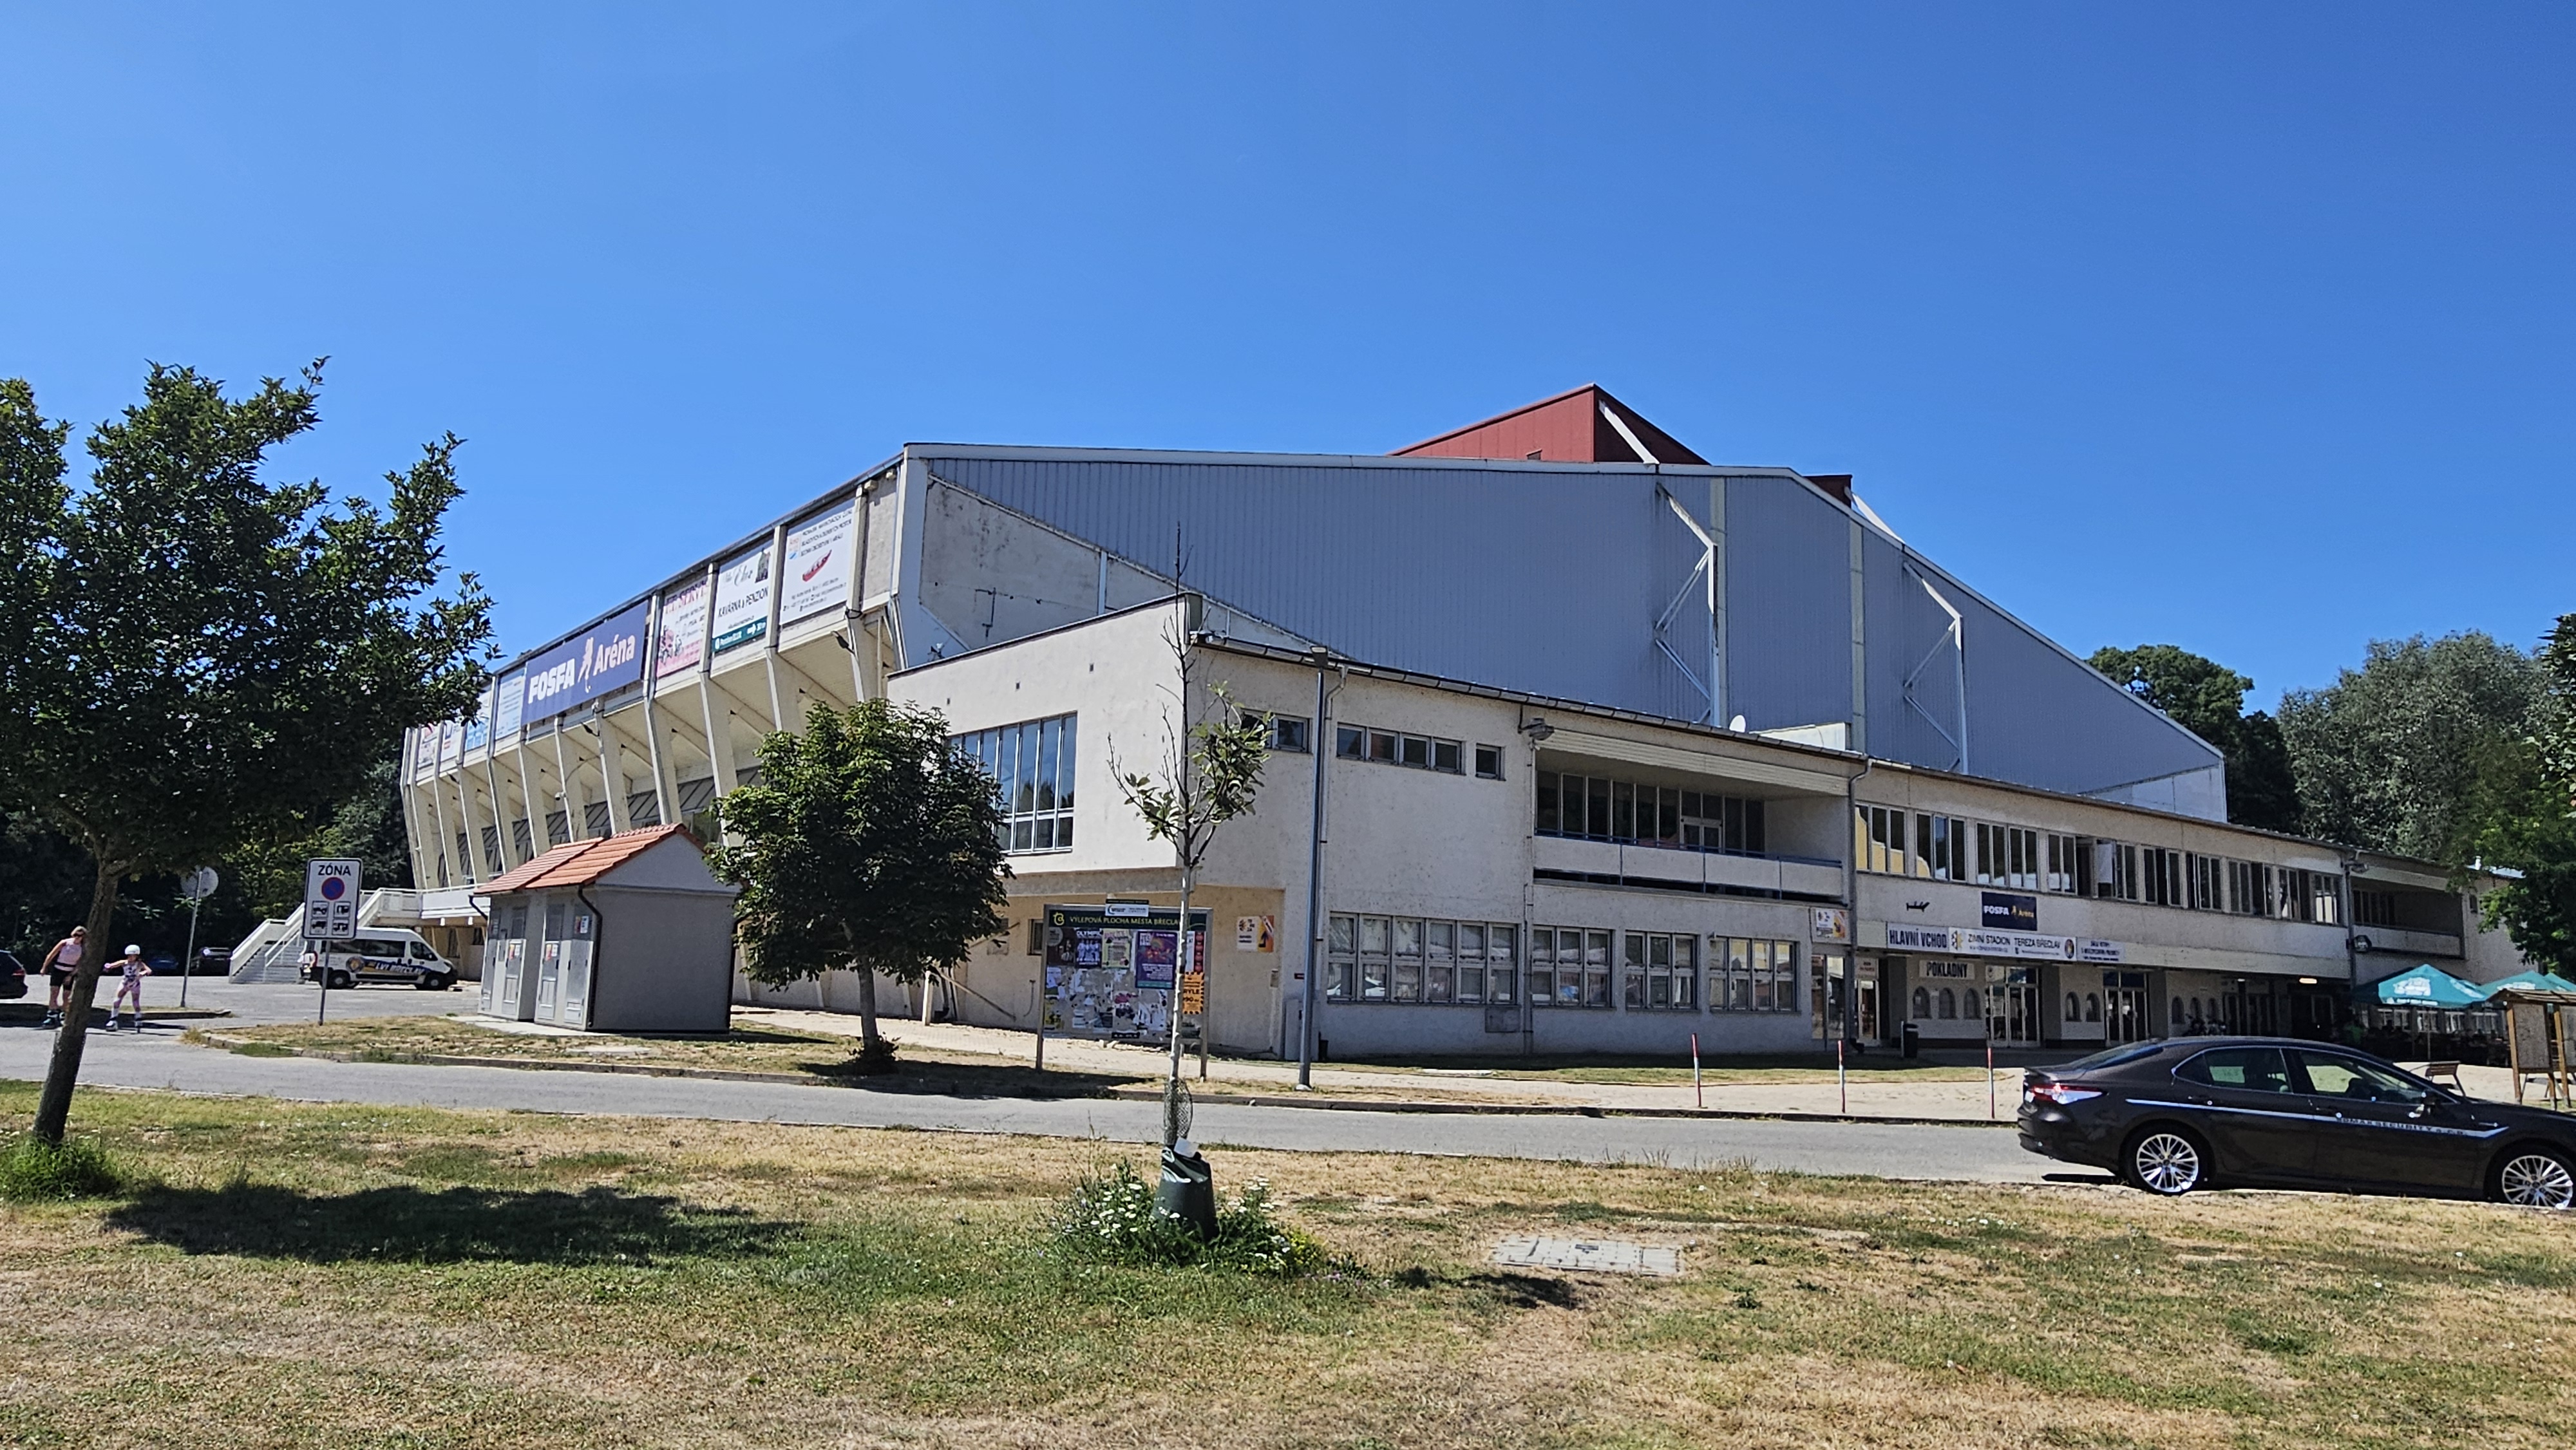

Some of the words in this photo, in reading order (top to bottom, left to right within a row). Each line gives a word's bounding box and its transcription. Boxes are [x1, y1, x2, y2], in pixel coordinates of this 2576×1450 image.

[528, 658, 575, 704] FOSFA
[592, 634, 636, 677] Aréna
[317, 863, 351, 876] ZÓNA
[1983, 905, 2009, 915] FOSFA
[1889, 928, 1918, 946] HLAVNÍ
[1920, 932, 1947, 948] VCHOD
[1985, 935, 2011, 945] STADION
[2014, 937, 2036, 947] TEREZA
[2036, 937, 2060, 948] BŘECLAV
[1926, 962, 1967, 977] POKLADNY
